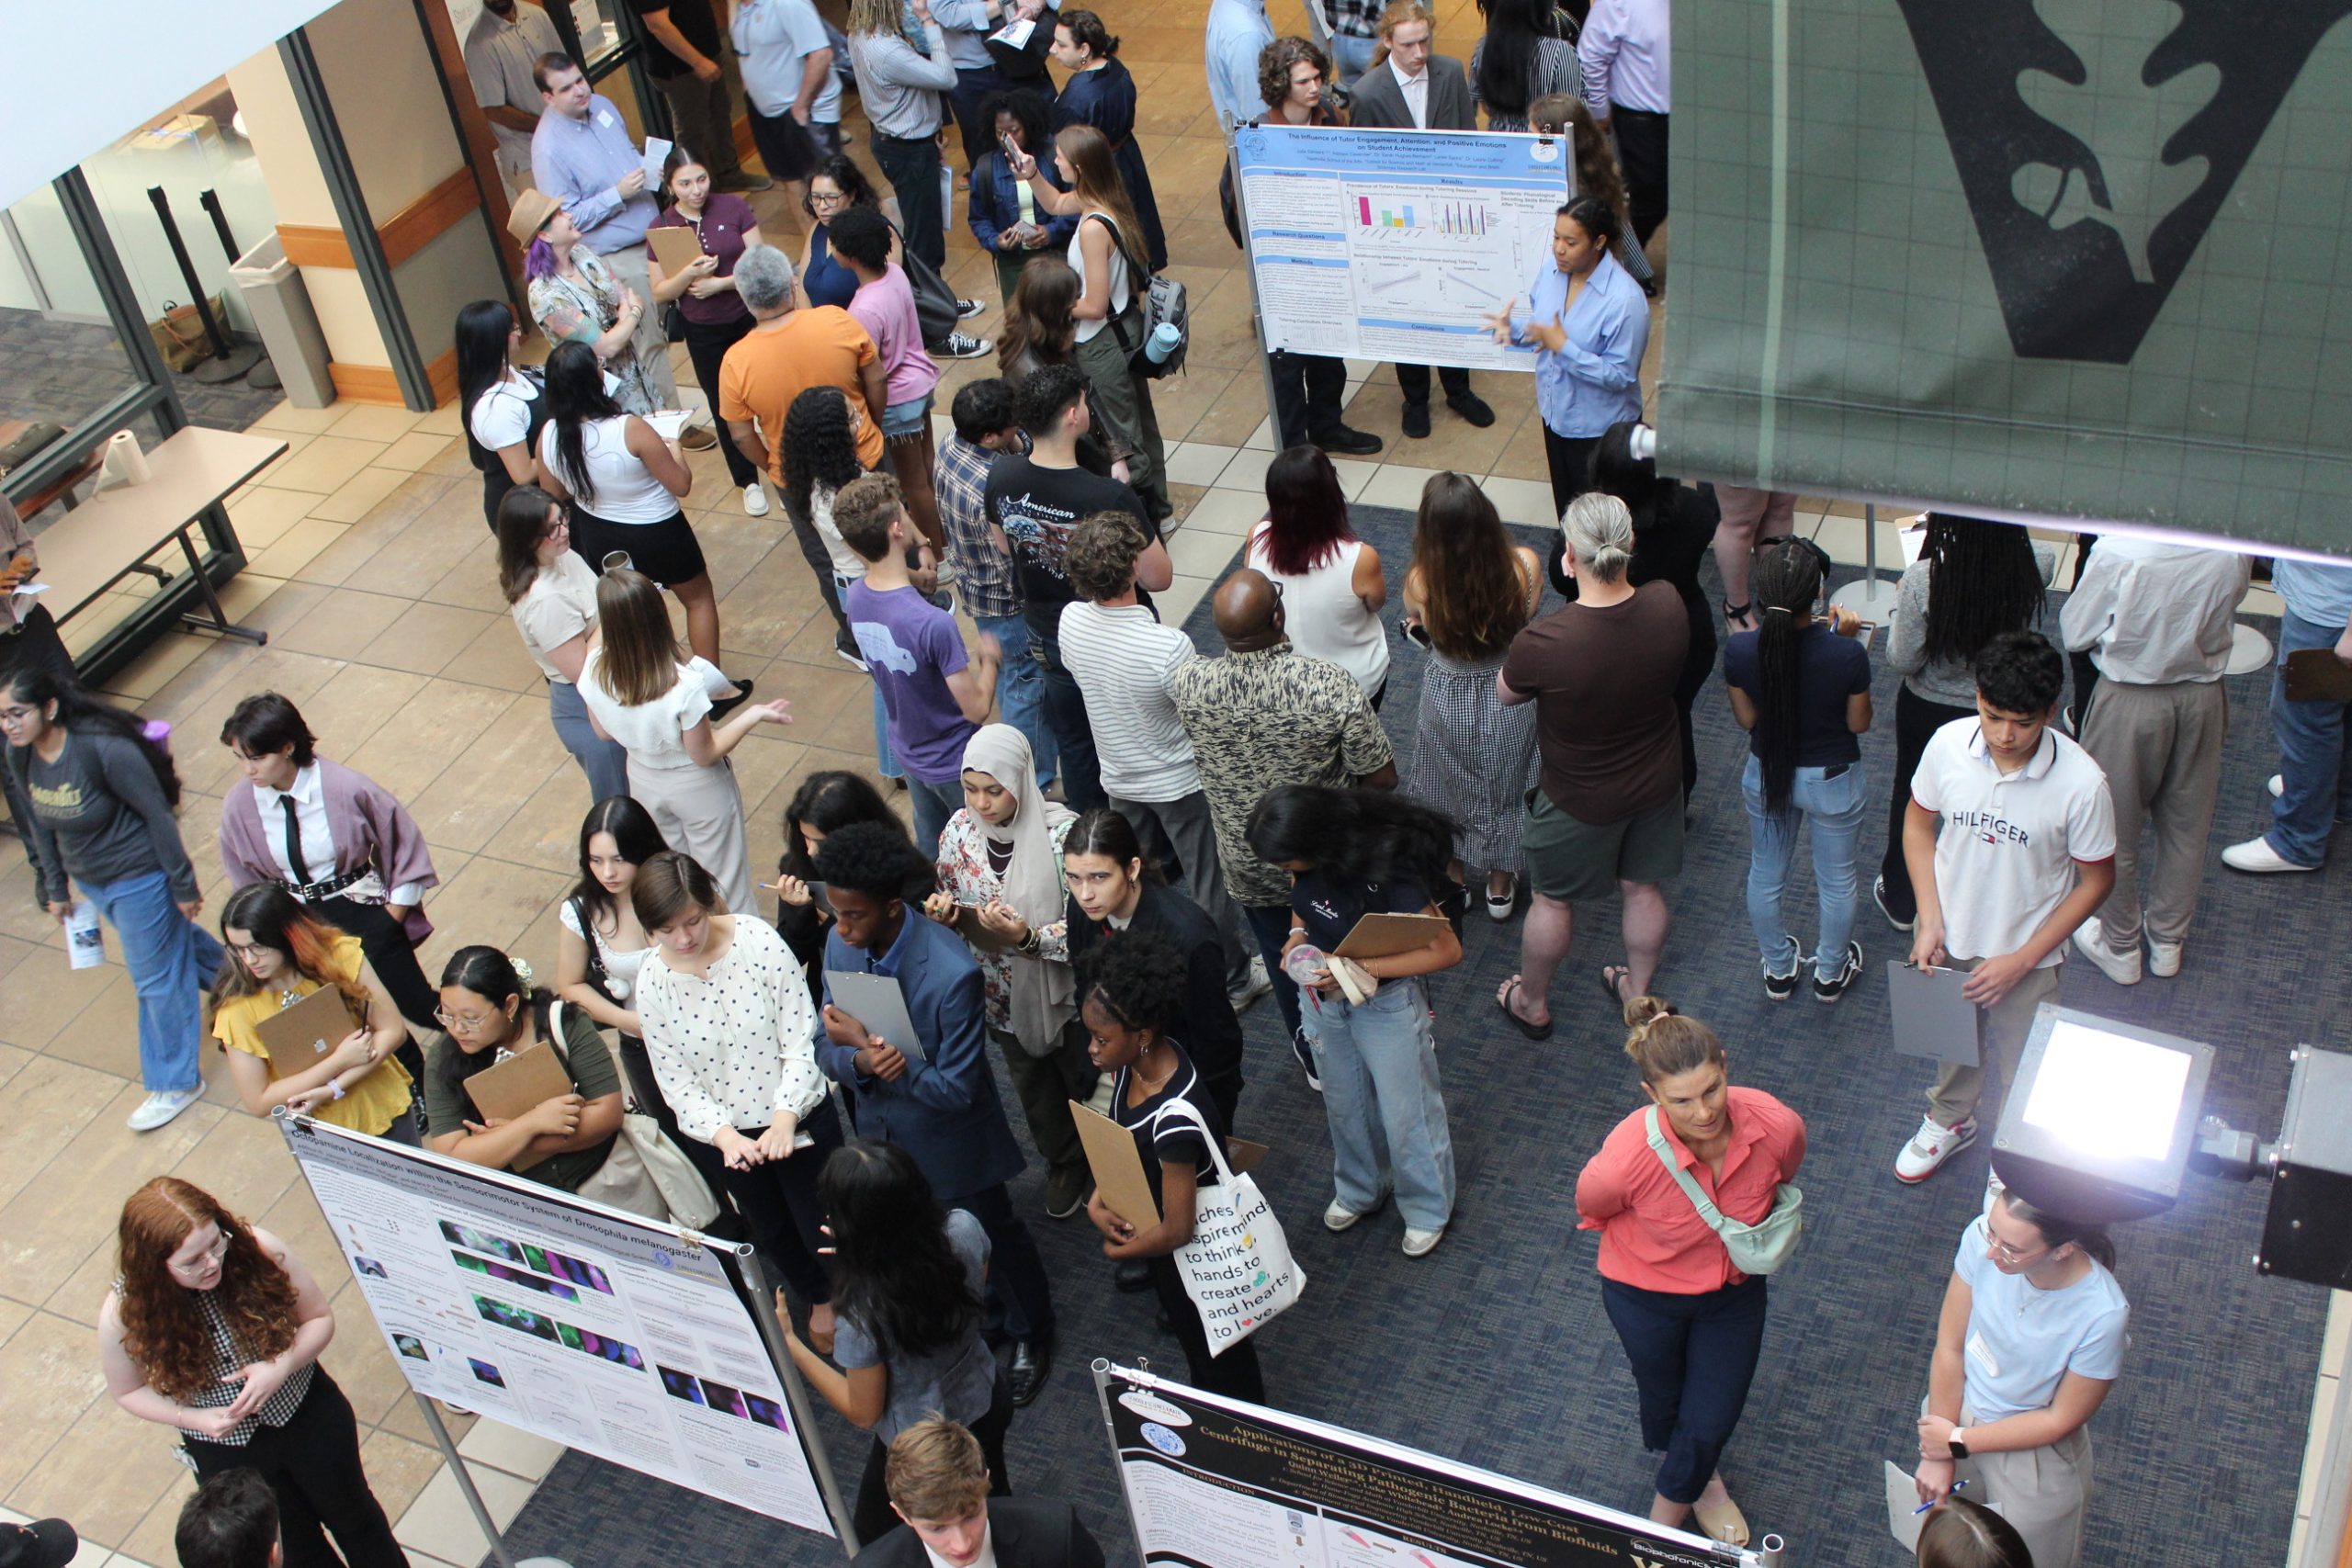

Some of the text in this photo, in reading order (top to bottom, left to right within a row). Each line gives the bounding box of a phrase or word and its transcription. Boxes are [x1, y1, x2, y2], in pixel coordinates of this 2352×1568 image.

[1005, 492, 1076, 519] American
[1952, 811, 2030, 849] HILFIGER
[290, 1129, 346, 1153] Octopamine
[346, 1146, 403, 1172] Localization
[405, 1166, 435, 1180] within
[435, 1175, 452, 1186] the
[453, 1180, 520, 1207] Sensorimotor
[521, 1201, 560, 1220] System
[560, 1213, 572, 1223] of
[573, 1217, 628, 1243] Drosophila
[628, 1234, 704, 1264] melanogaster
[1185, 1242, 1246, 1264] to think
[1192, 1256, 1261, 1282] hands to
[1201, 1283, 1251, 1301] create
[1207, 1272, 1289, 1320] and hearts
[1214, 1307, 1278, 1339] to lve.
[1182, 1468, 1255, 1496] INTRODUCTION
[1199, 1424, 1618, 1555] Centrifuge in Separating Pathogenic Bacteria from Biofluids
[1232, 1425, 1317, 1458] Applications
[1319, 1451, 1334, 1461] of
[1348, 1461, 1368, 1472] 3D
[1371, 1467, 1428, 1490] Printed,
[1432, 1485, 1507, 1514] Handheld,
[1510, 1507, 1579, 1535] Low-Cost
[1287, 1460, 1317, 1474] Quinn
[1363, 1482, 1385, 1495] Luke
[1447, 1507, 1482, 1523] Andrea
[1402, 1534, 1448, 1553] RESULTS
